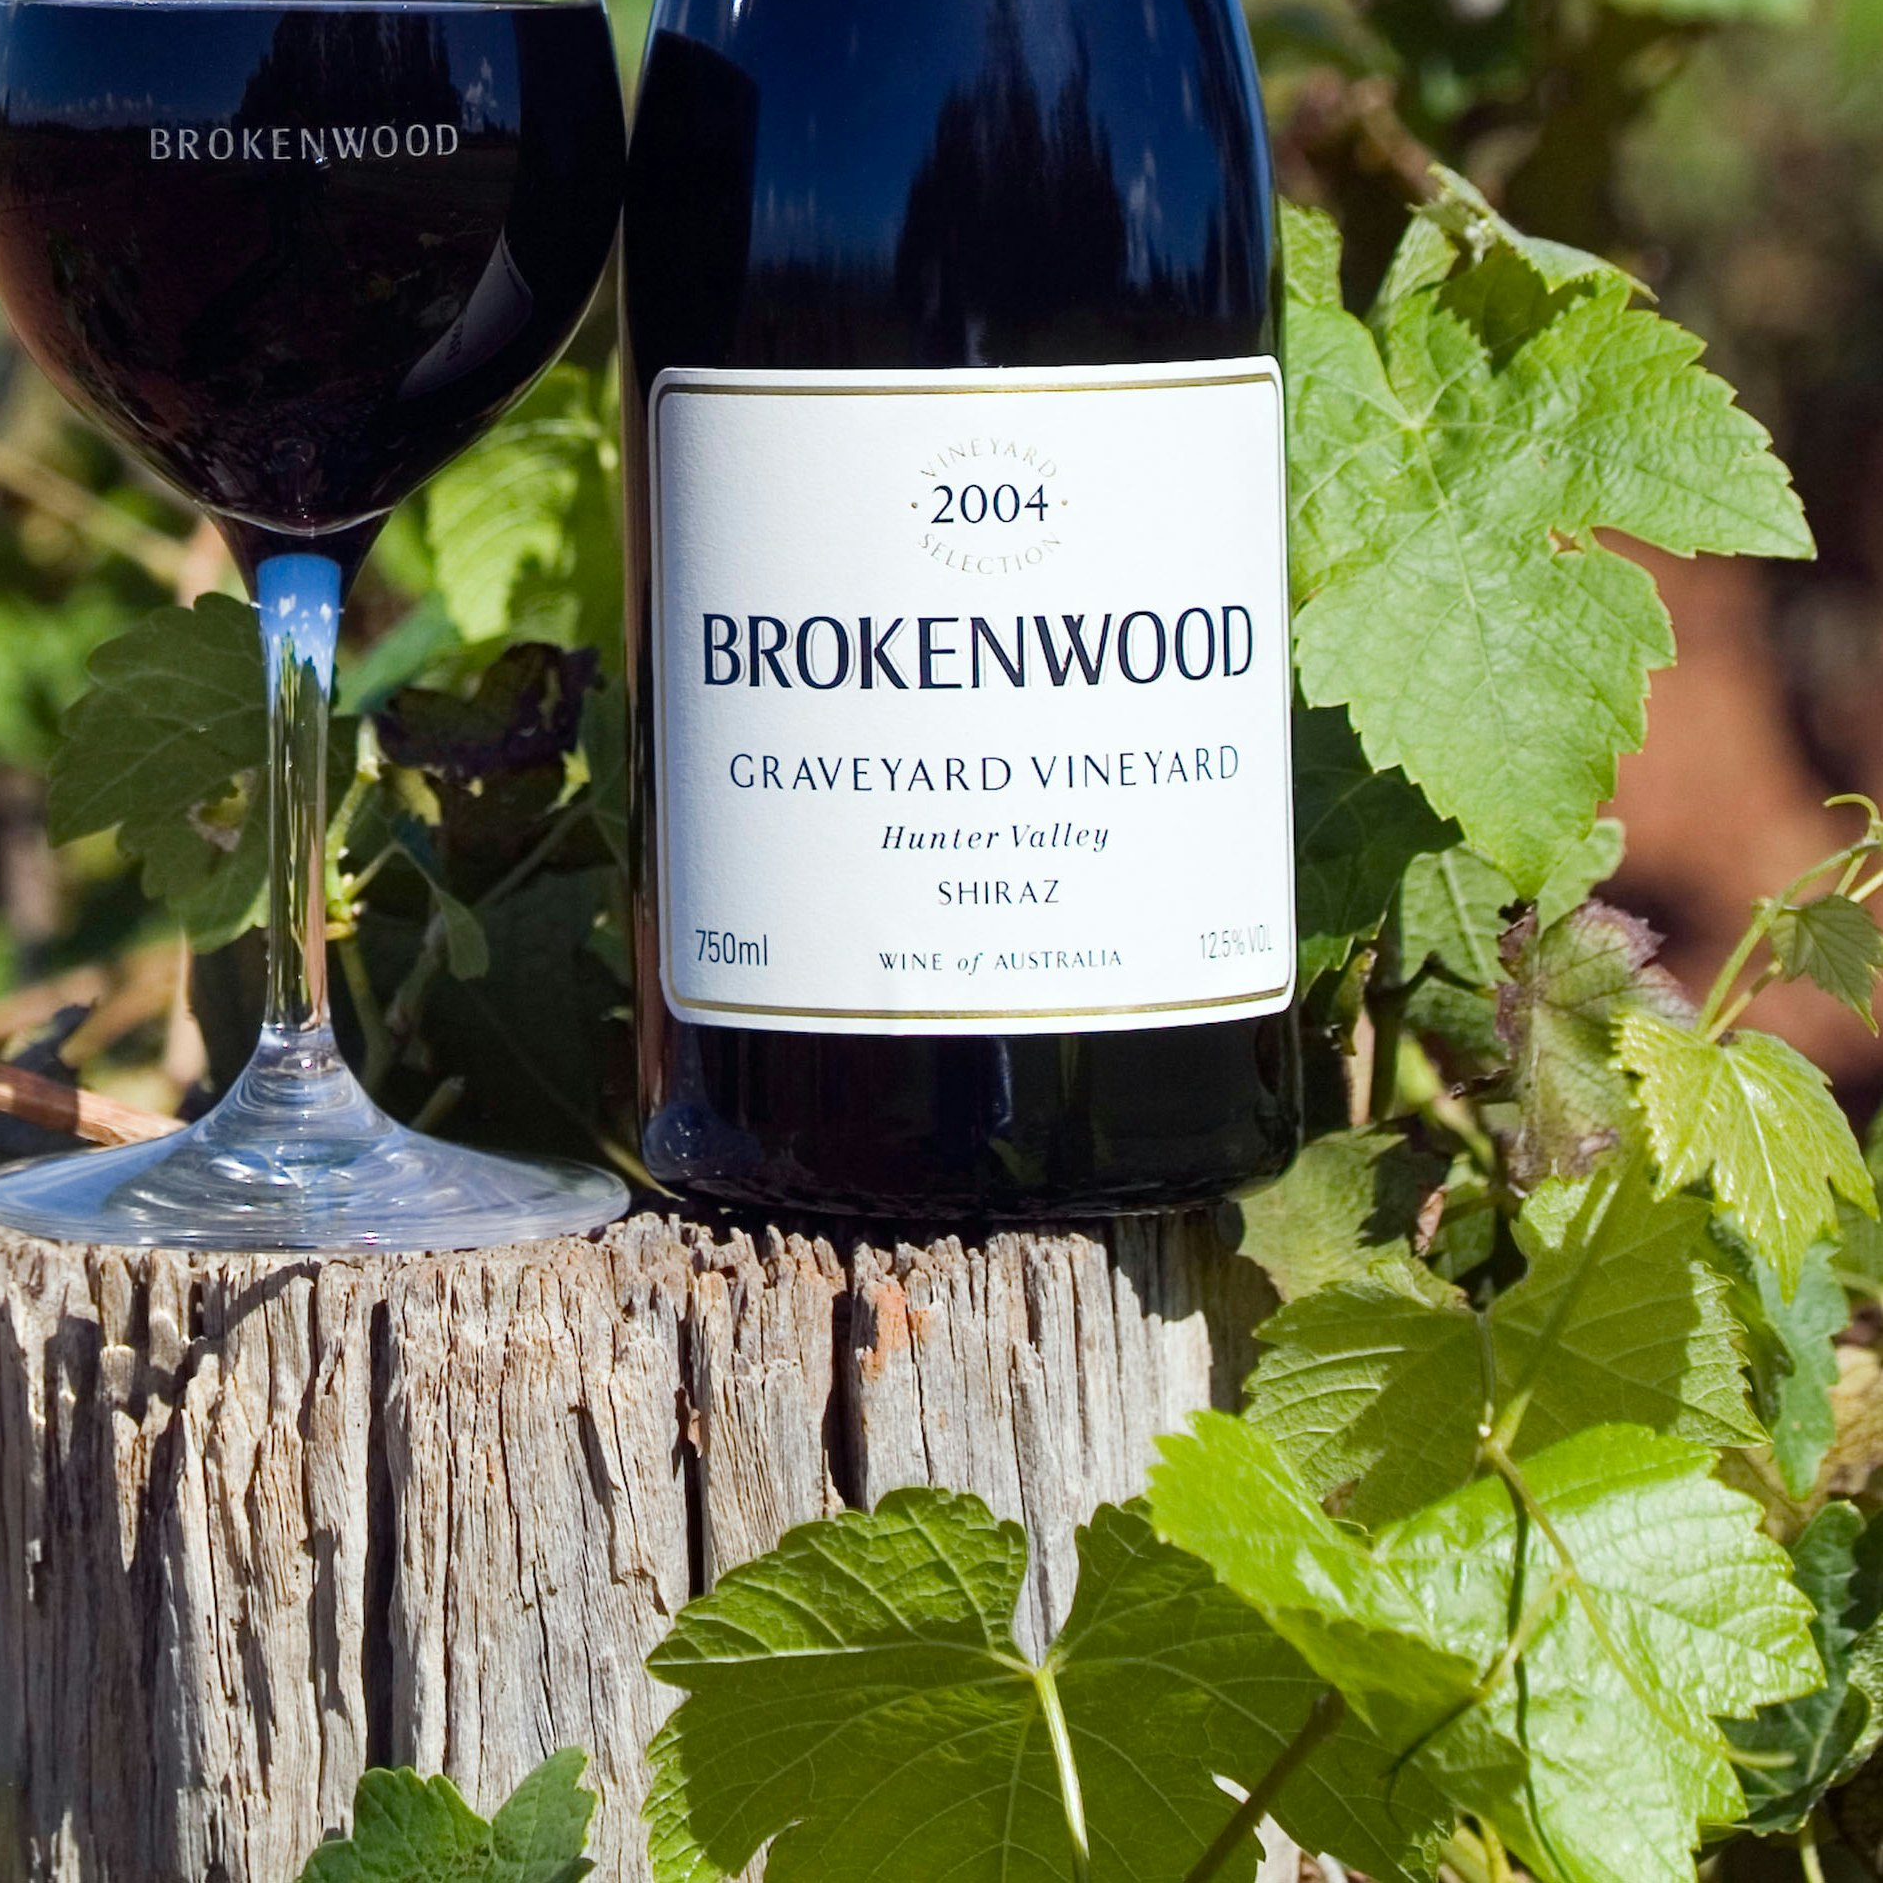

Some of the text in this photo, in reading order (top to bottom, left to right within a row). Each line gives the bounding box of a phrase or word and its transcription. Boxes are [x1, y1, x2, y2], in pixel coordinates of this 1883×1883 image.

[149, 124, 459, 160] BROKENWOOD
[920, 437, 1057, 478] VINEYARD
[931, 483, 1049, 524] 2004
[918, 531, 1062, 574] SELECTION
[702, 604, 1254, 691] BROKENWOOD
[729, 744, 1240, 792] GRAVEYARD VINEYARD
[880, 822, 1111, 853] Hunter Valley
[937, 879, 1061, 906] SHIRAZ
[694, 928, 769, 968] 750ml
[879, 949, 1122, 975] WINE of AUSTRALIA
